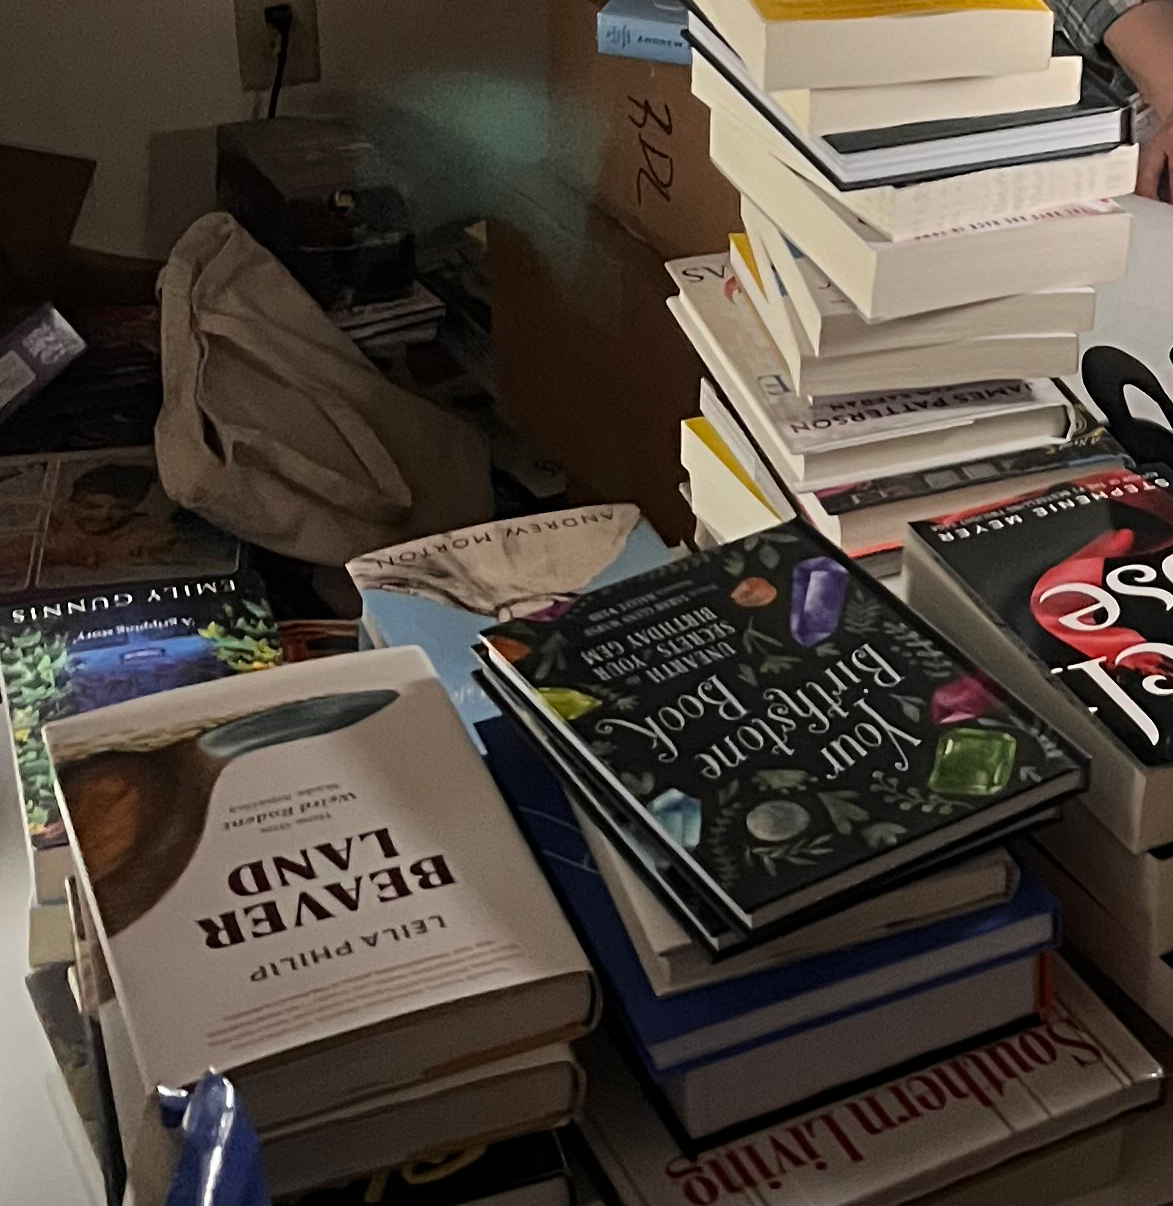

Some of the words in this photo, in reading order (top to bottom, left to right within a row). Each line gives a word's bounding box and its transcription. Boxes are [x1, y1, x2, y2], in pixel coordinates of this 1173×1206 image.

[790, 395, 938, 433] PATTERSON
[942, 381, 1034, 410] JAMES
[1032, 477, 1170, 518] STEPHENIE
[504, 510, 616, 539] ANDREW
[938, 514, 1023, 542] MEYER
[377, 531, 494, 570] MORTON
[11, 592, 133, 624] GUNNIS
[147, 578, 236, 601] EMILY
[627, 606, 718, 649] BIRTHDAY
[656, 621, 736, 658] SECRETS
[580, 640, 625, 666] GEM
[591, 654, 649, 681] YOUR
[646, 641, 737, 683] UNEARTH
[595, 675, 749, 762] Book
[695, 644, 905, 779] Birthstone
[820, 698, 922, 780] Your
[222, 806, 294, 830] Rodent
[299, 792, 357, 814] Weird
[228, 828, 400, 897] LAND
[195, 855, 457, 949] BEAVER
[360, 914, 447, 948] LEILA
[249, 941, 355, 982] PHILIP
[844, 1017, 1105, 1135] Southern
[665, 1112, 865, 1206] Living
